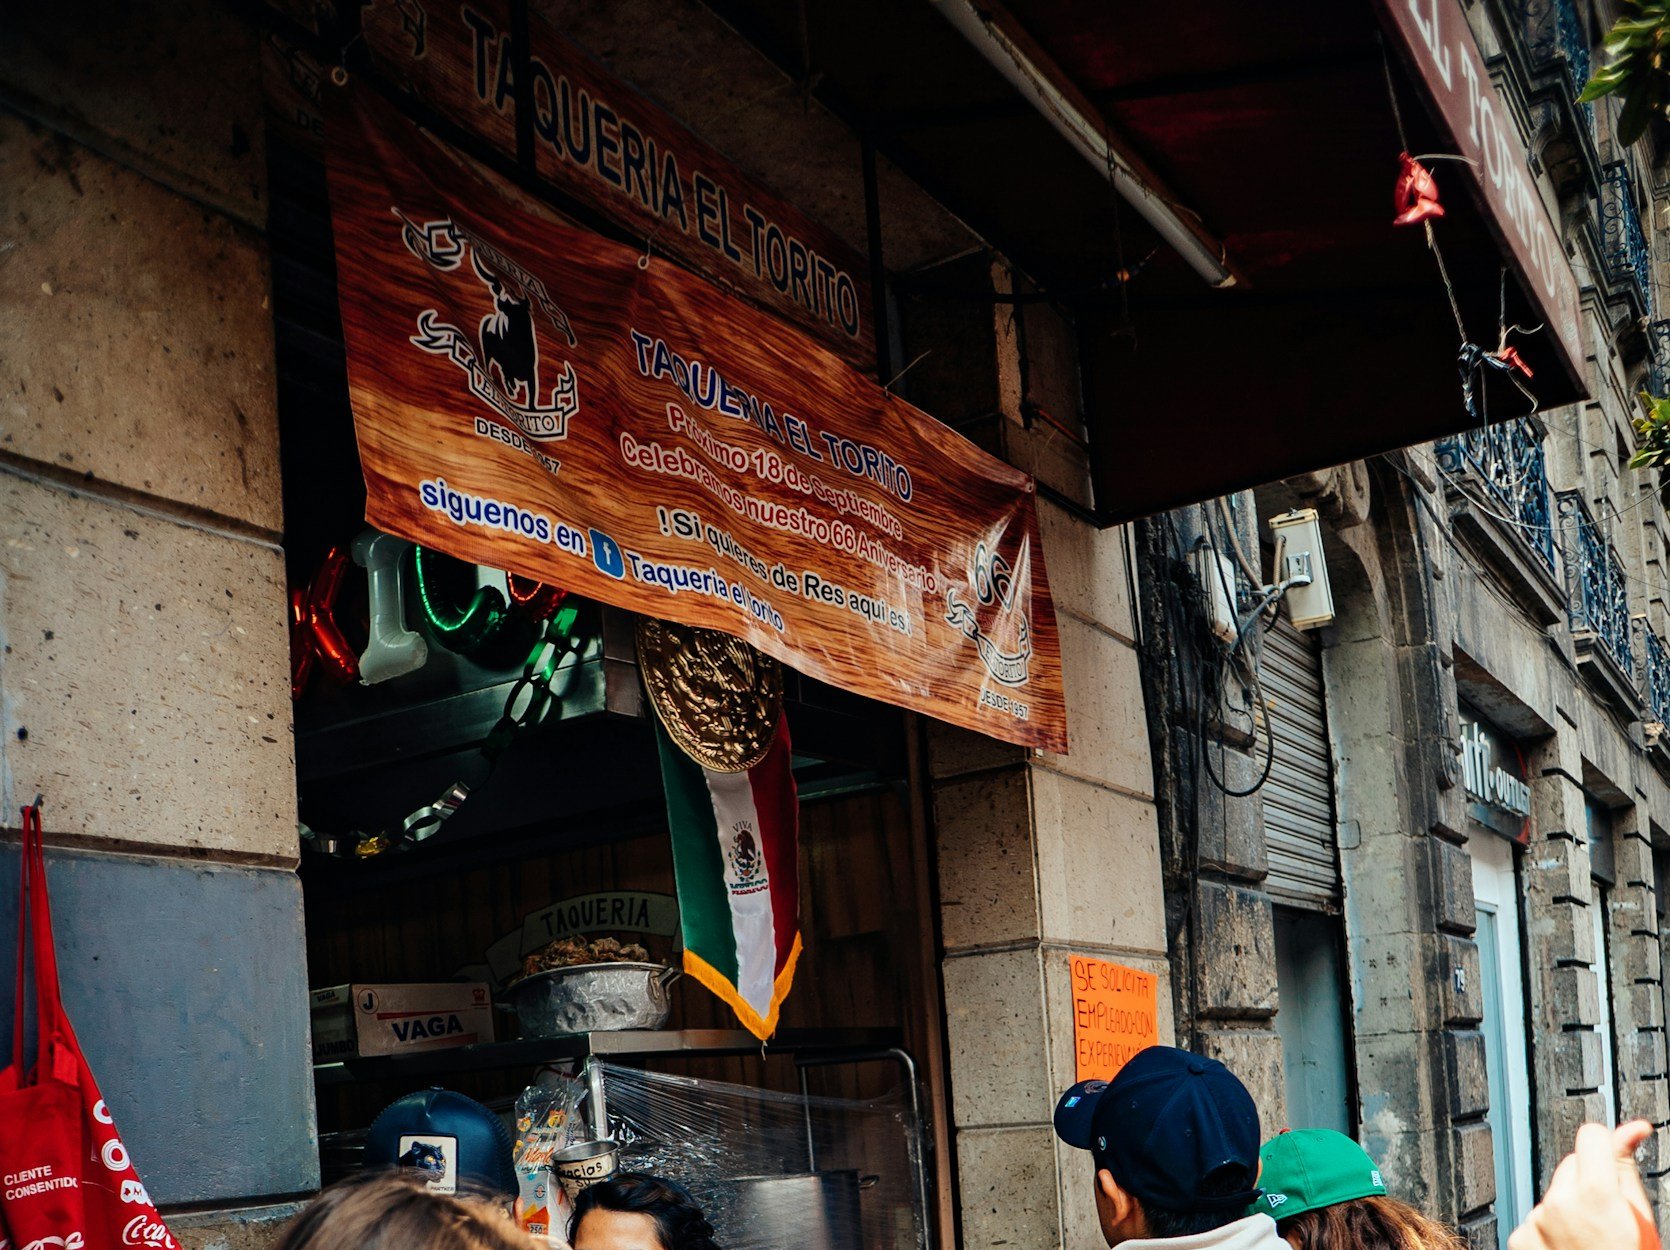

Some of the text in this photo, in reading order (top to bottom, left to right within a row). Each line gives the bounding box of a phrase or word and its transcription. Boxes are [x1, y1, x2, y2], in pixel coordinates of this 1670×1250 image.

[462, 6, 860, 338] TAQUERIA EL TORITO
[631, 329, 912, 502] TAQUERIA EL TORITO
[476, 418, 532, 455] DESDE
[621, 433, 937, 593] Celebramos nuestro 66 Aniversario
[753, 449, 782, 482] 18
[785, 464, 812, 493] de
[810, 476, 902, 539] Septiembre
[420, 478, 551, 544] siguenos
[556, 522, 586, 557] en
[625, 552, 728, 601] Taqueria
[731, 583, 748, 609] el
[746, 588, 784, 632] torito
[706, 524, 768, 582] quieres
[771, 563, 798, 594] de
[803, 571, 845, 607] Res
[850, 591, 886, 622] aqui
[732, 820, 752, 833] VIVA
[540, 897, 650, 936] TAQUERIA
[1074, 960, 1149, 998] SE SOLICITA
[392, 1014, 464, 1042] VAGA
[316, 1040, 355, 1056] JUMBO
[4, 1165, 52, 1186] CLIENTE
[530, 1225, 543, 1234] 250
